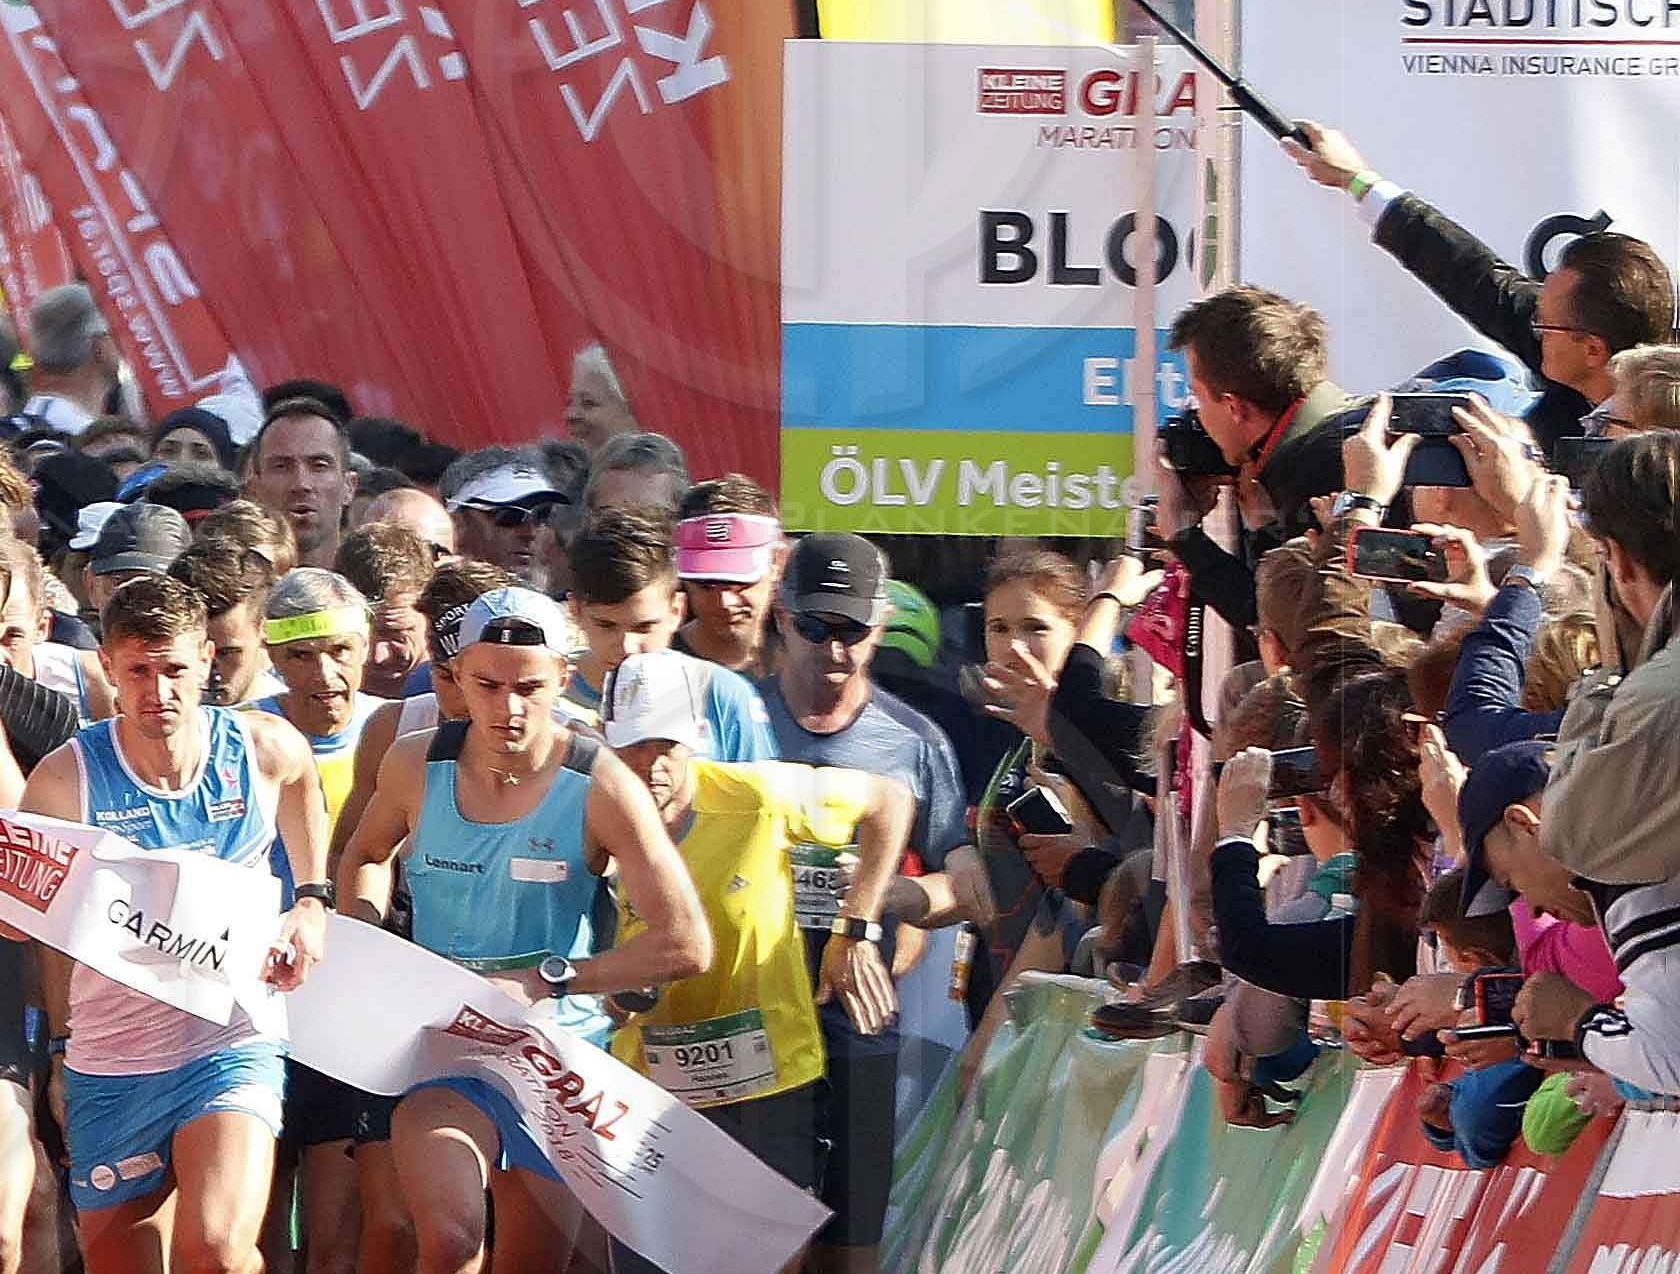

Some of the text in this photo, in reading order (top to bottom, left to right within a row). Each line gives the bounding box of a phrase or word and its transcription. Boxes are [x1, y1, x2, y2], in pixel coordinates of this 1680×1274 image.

[1402, 54, 1494, 76] VIENNA
[1501, 54, 1640, 76] INSURANCE
[982, 74, 1064, 92] KLEINE
[819, 444, 960, 507] ÖLV
[424, 852, 486, 875] Lennart
[107, 898, 226, 972] GARMIN
[673, 1042, 735, 1069] 9201
